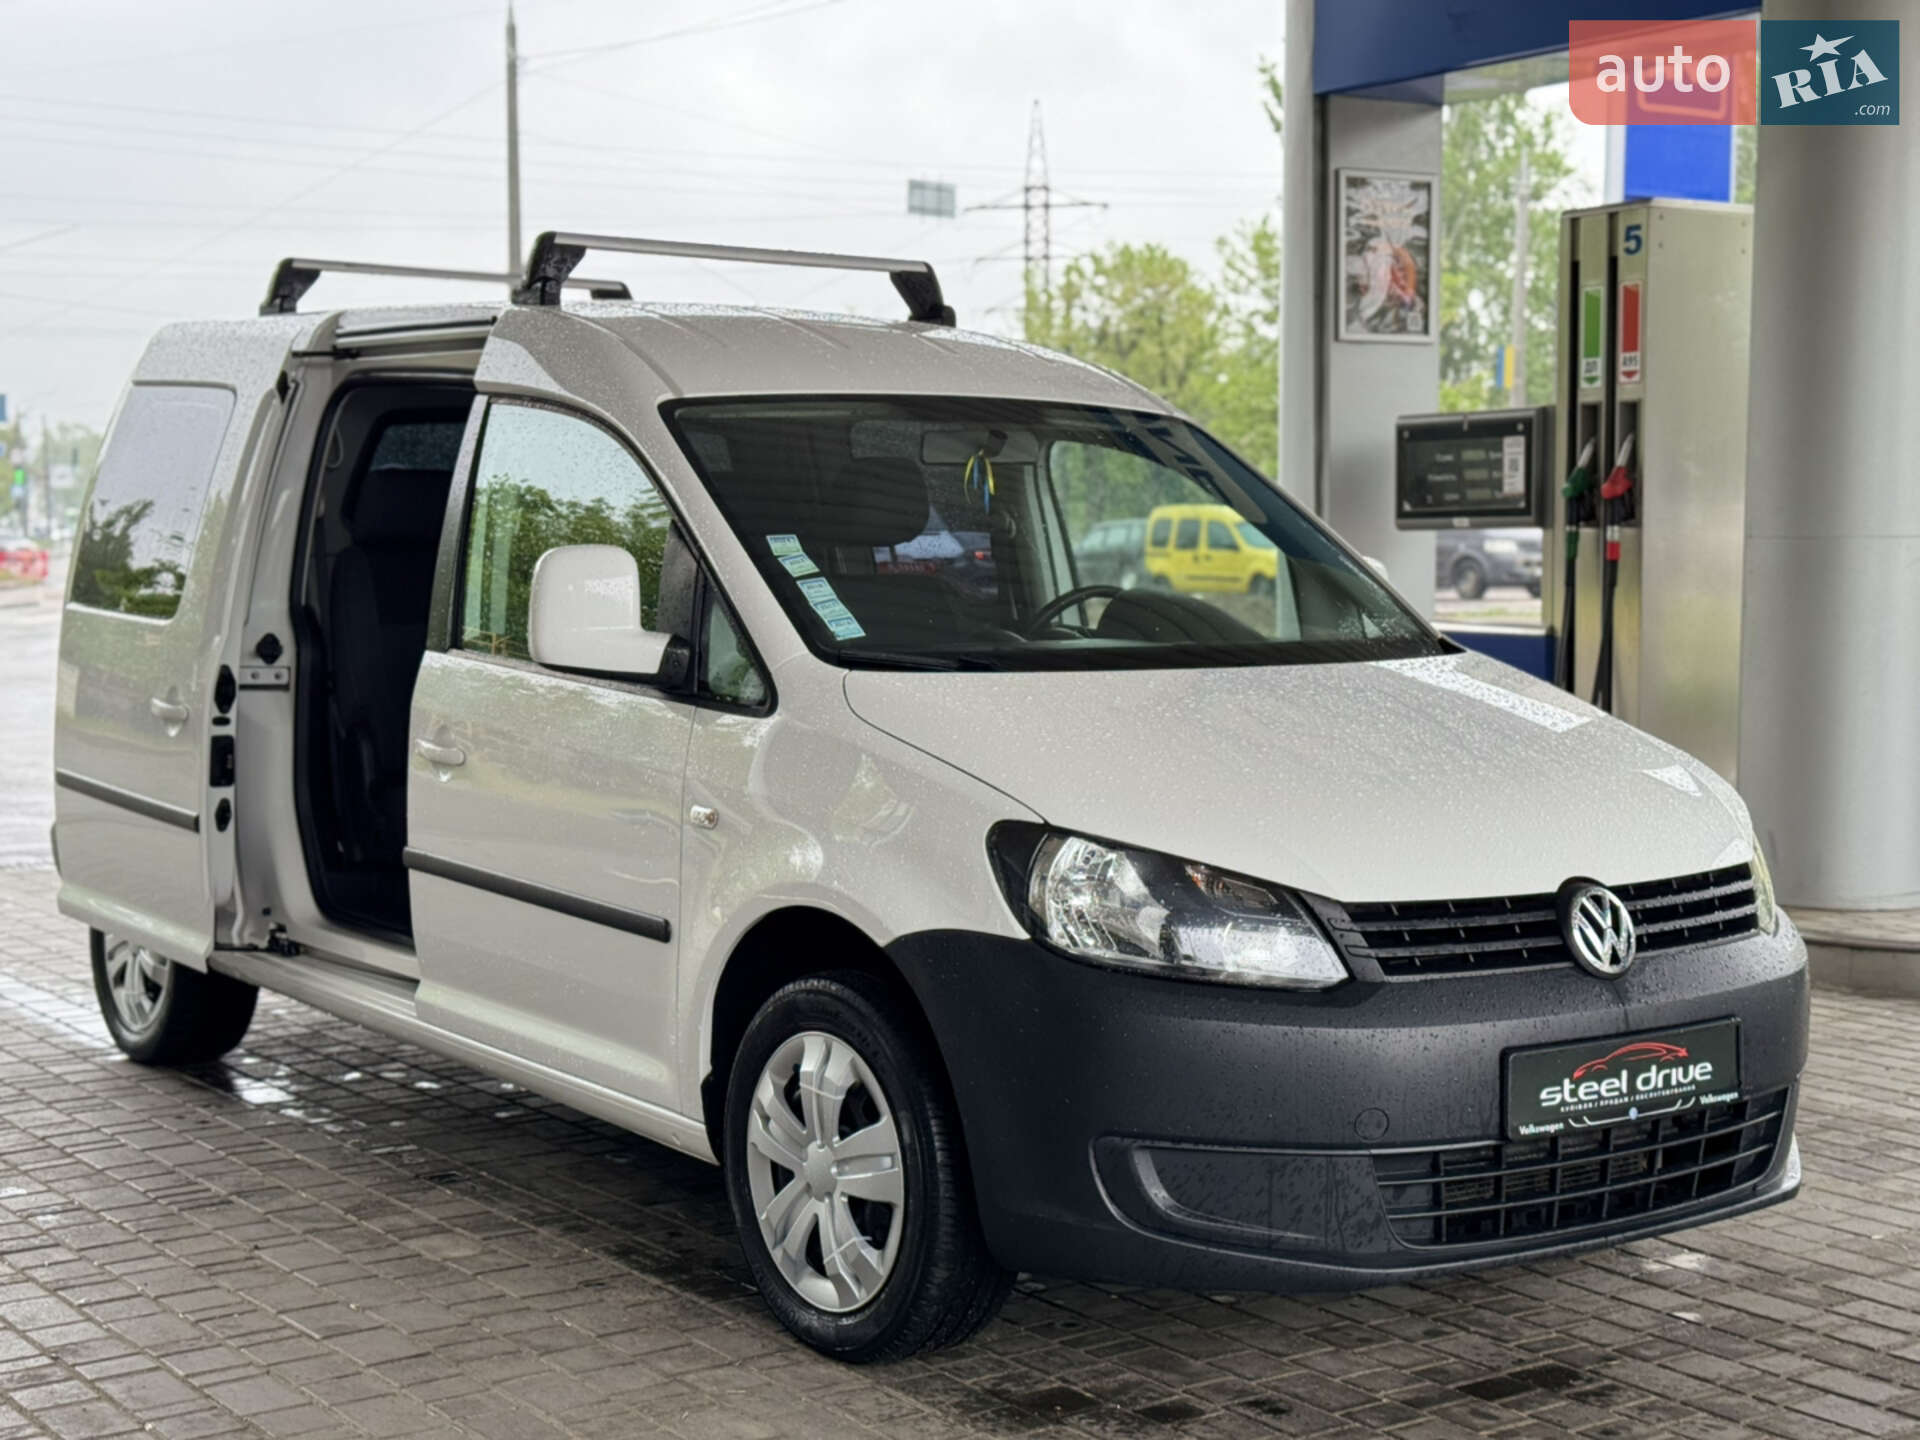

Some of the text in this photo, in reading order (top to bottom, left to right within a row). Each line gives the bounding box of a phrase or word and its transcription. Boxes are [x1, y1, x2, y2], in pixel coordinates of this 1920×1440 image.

[1623, 224, 1643, 255] 5
[1540, 1061, 1713, 1107] steel drive
